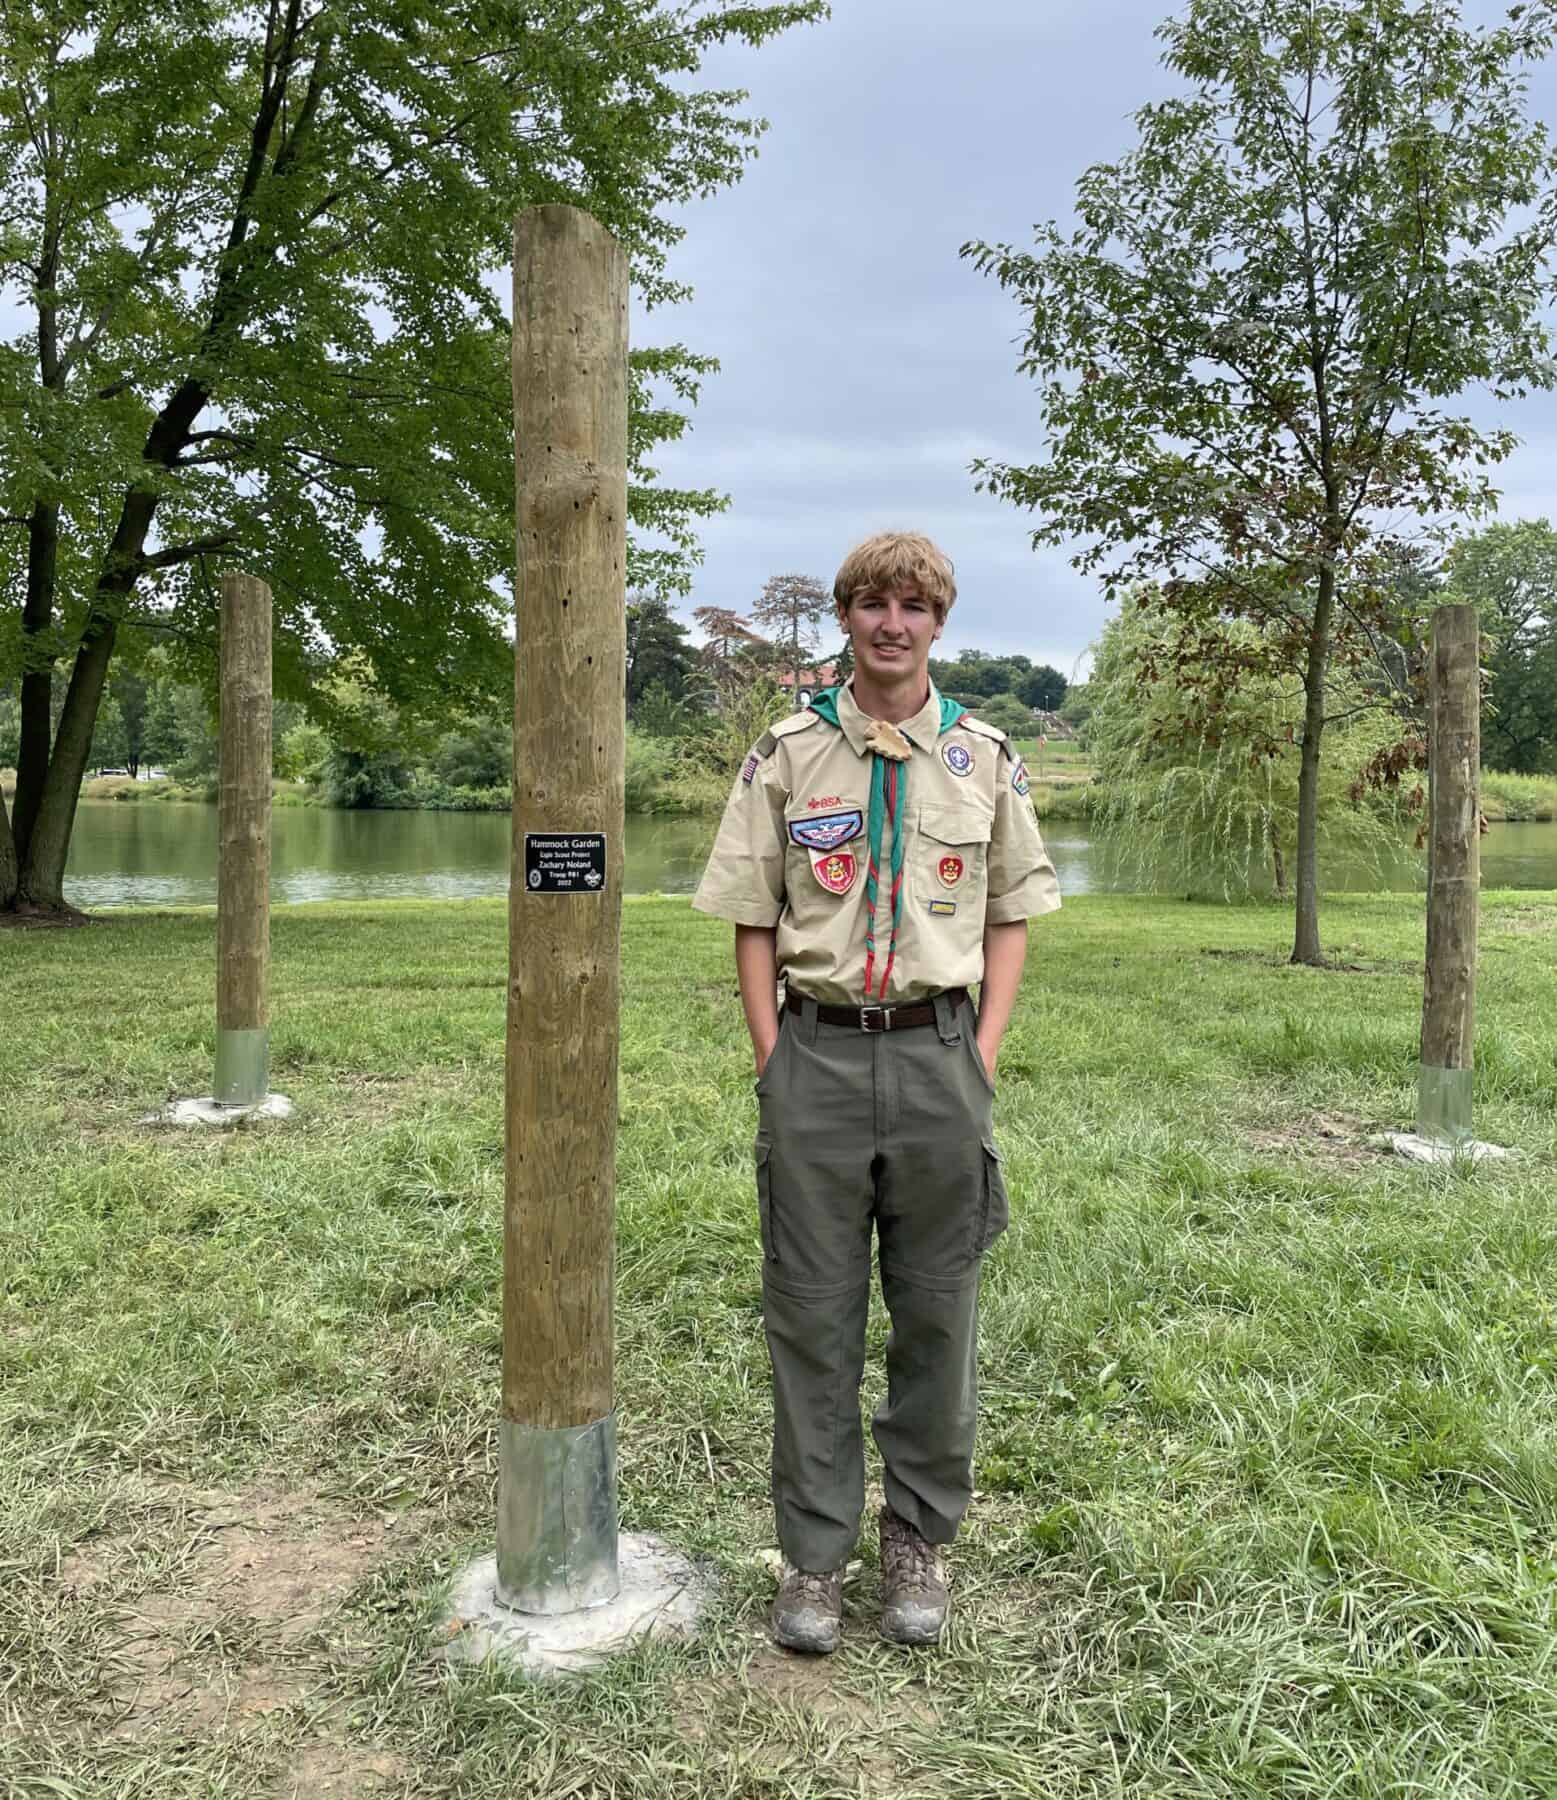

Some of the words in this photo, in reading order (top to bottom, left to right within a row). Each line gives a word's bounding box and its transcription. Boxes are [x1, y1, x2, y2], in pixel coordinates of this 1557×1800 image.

[821, 797, 841, 809] BSA
[531, 839, 570, 848] Hammock
[571, 839, 600, 848] Garden
[539, 861, 565, 870] Zachary
[566, 861, 591, 869] Noland
